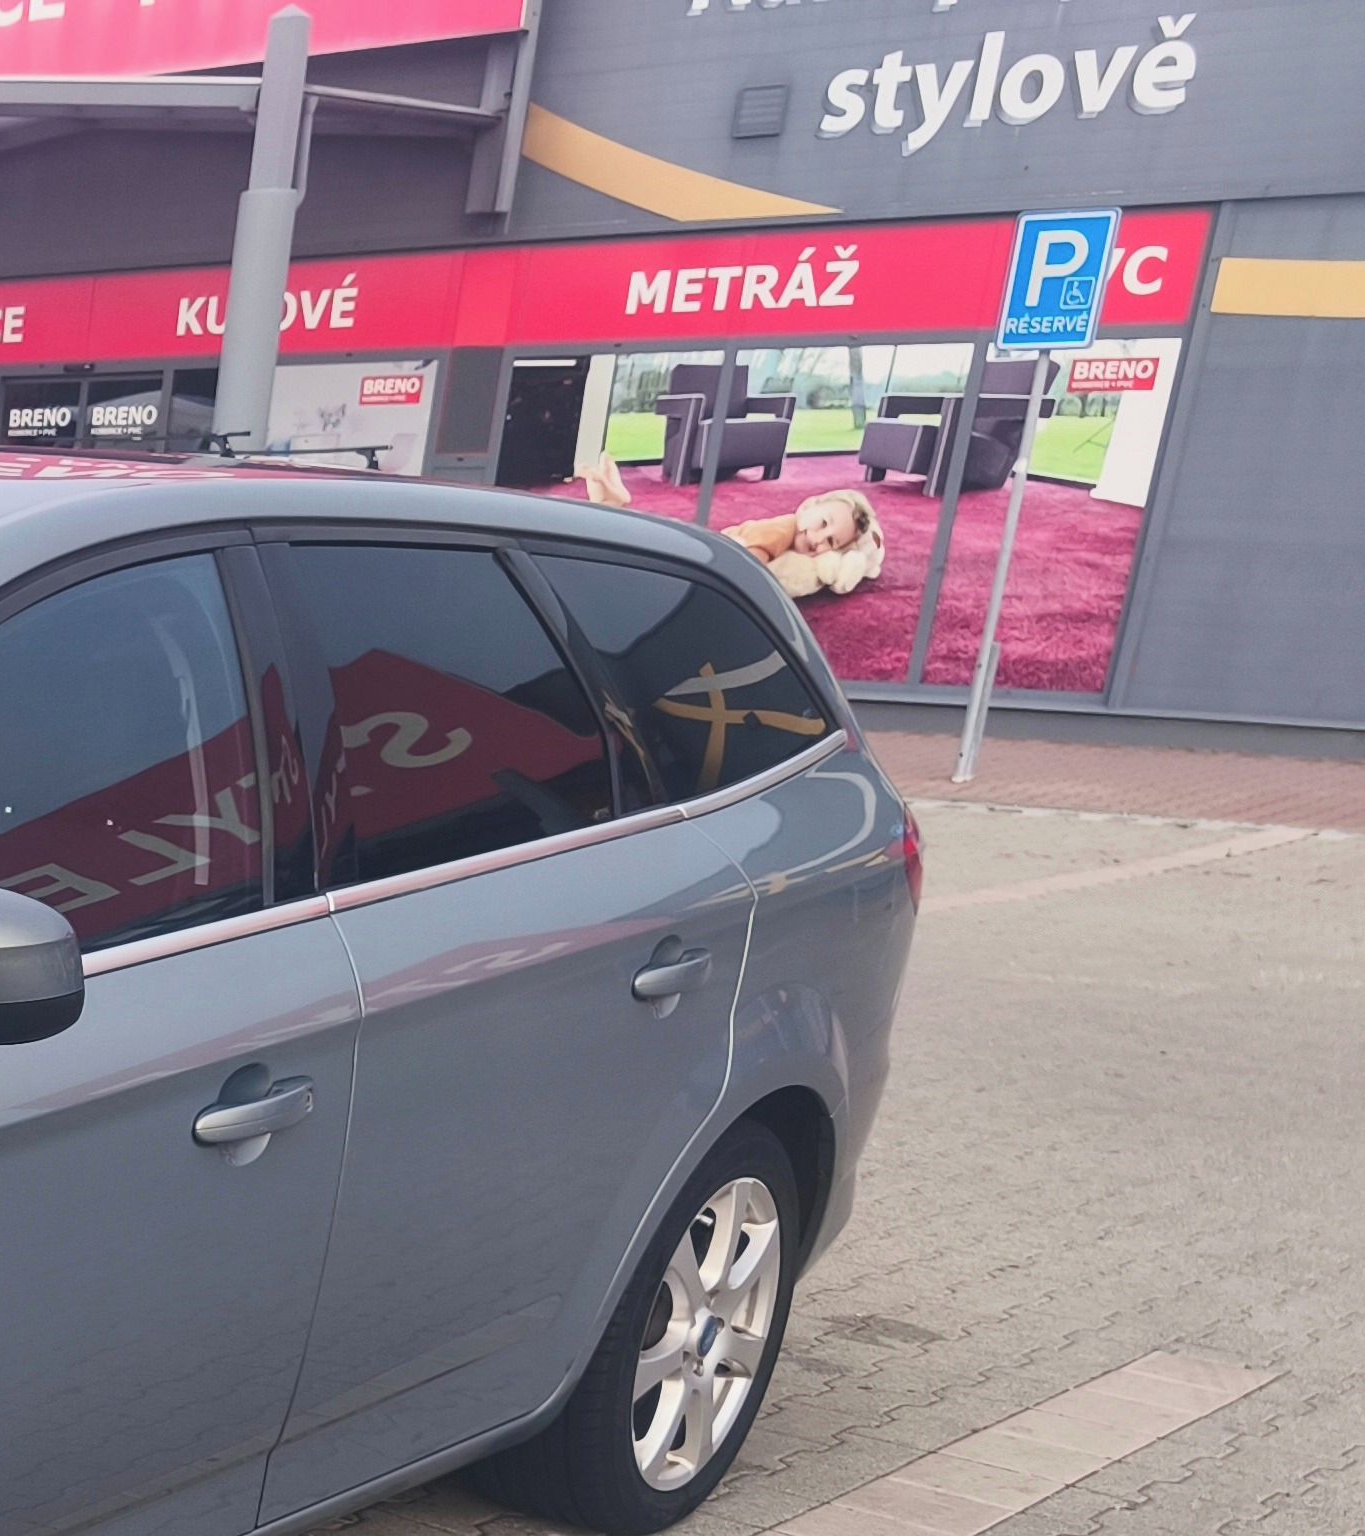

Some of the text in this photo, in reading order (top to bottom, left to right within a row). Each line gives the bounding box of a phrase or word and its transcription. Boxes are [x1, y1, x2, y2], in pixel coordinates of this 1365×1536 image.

[818, 12, 1197, 154] stylově
[625, 245, 860, 315] METRÁŽ
[1024, 229, 1089, 308] P
[176, 273, 359, 336] KUOVÉ
[1005, 311, 1089, 334] RÉSERVÉ
[1073, 360, 1154, 380] BRENO
[363, 377, 420, 395] BRENO
[9, 408, 71, 427] BRENO
[92, 405, 158, 425] BRENO
